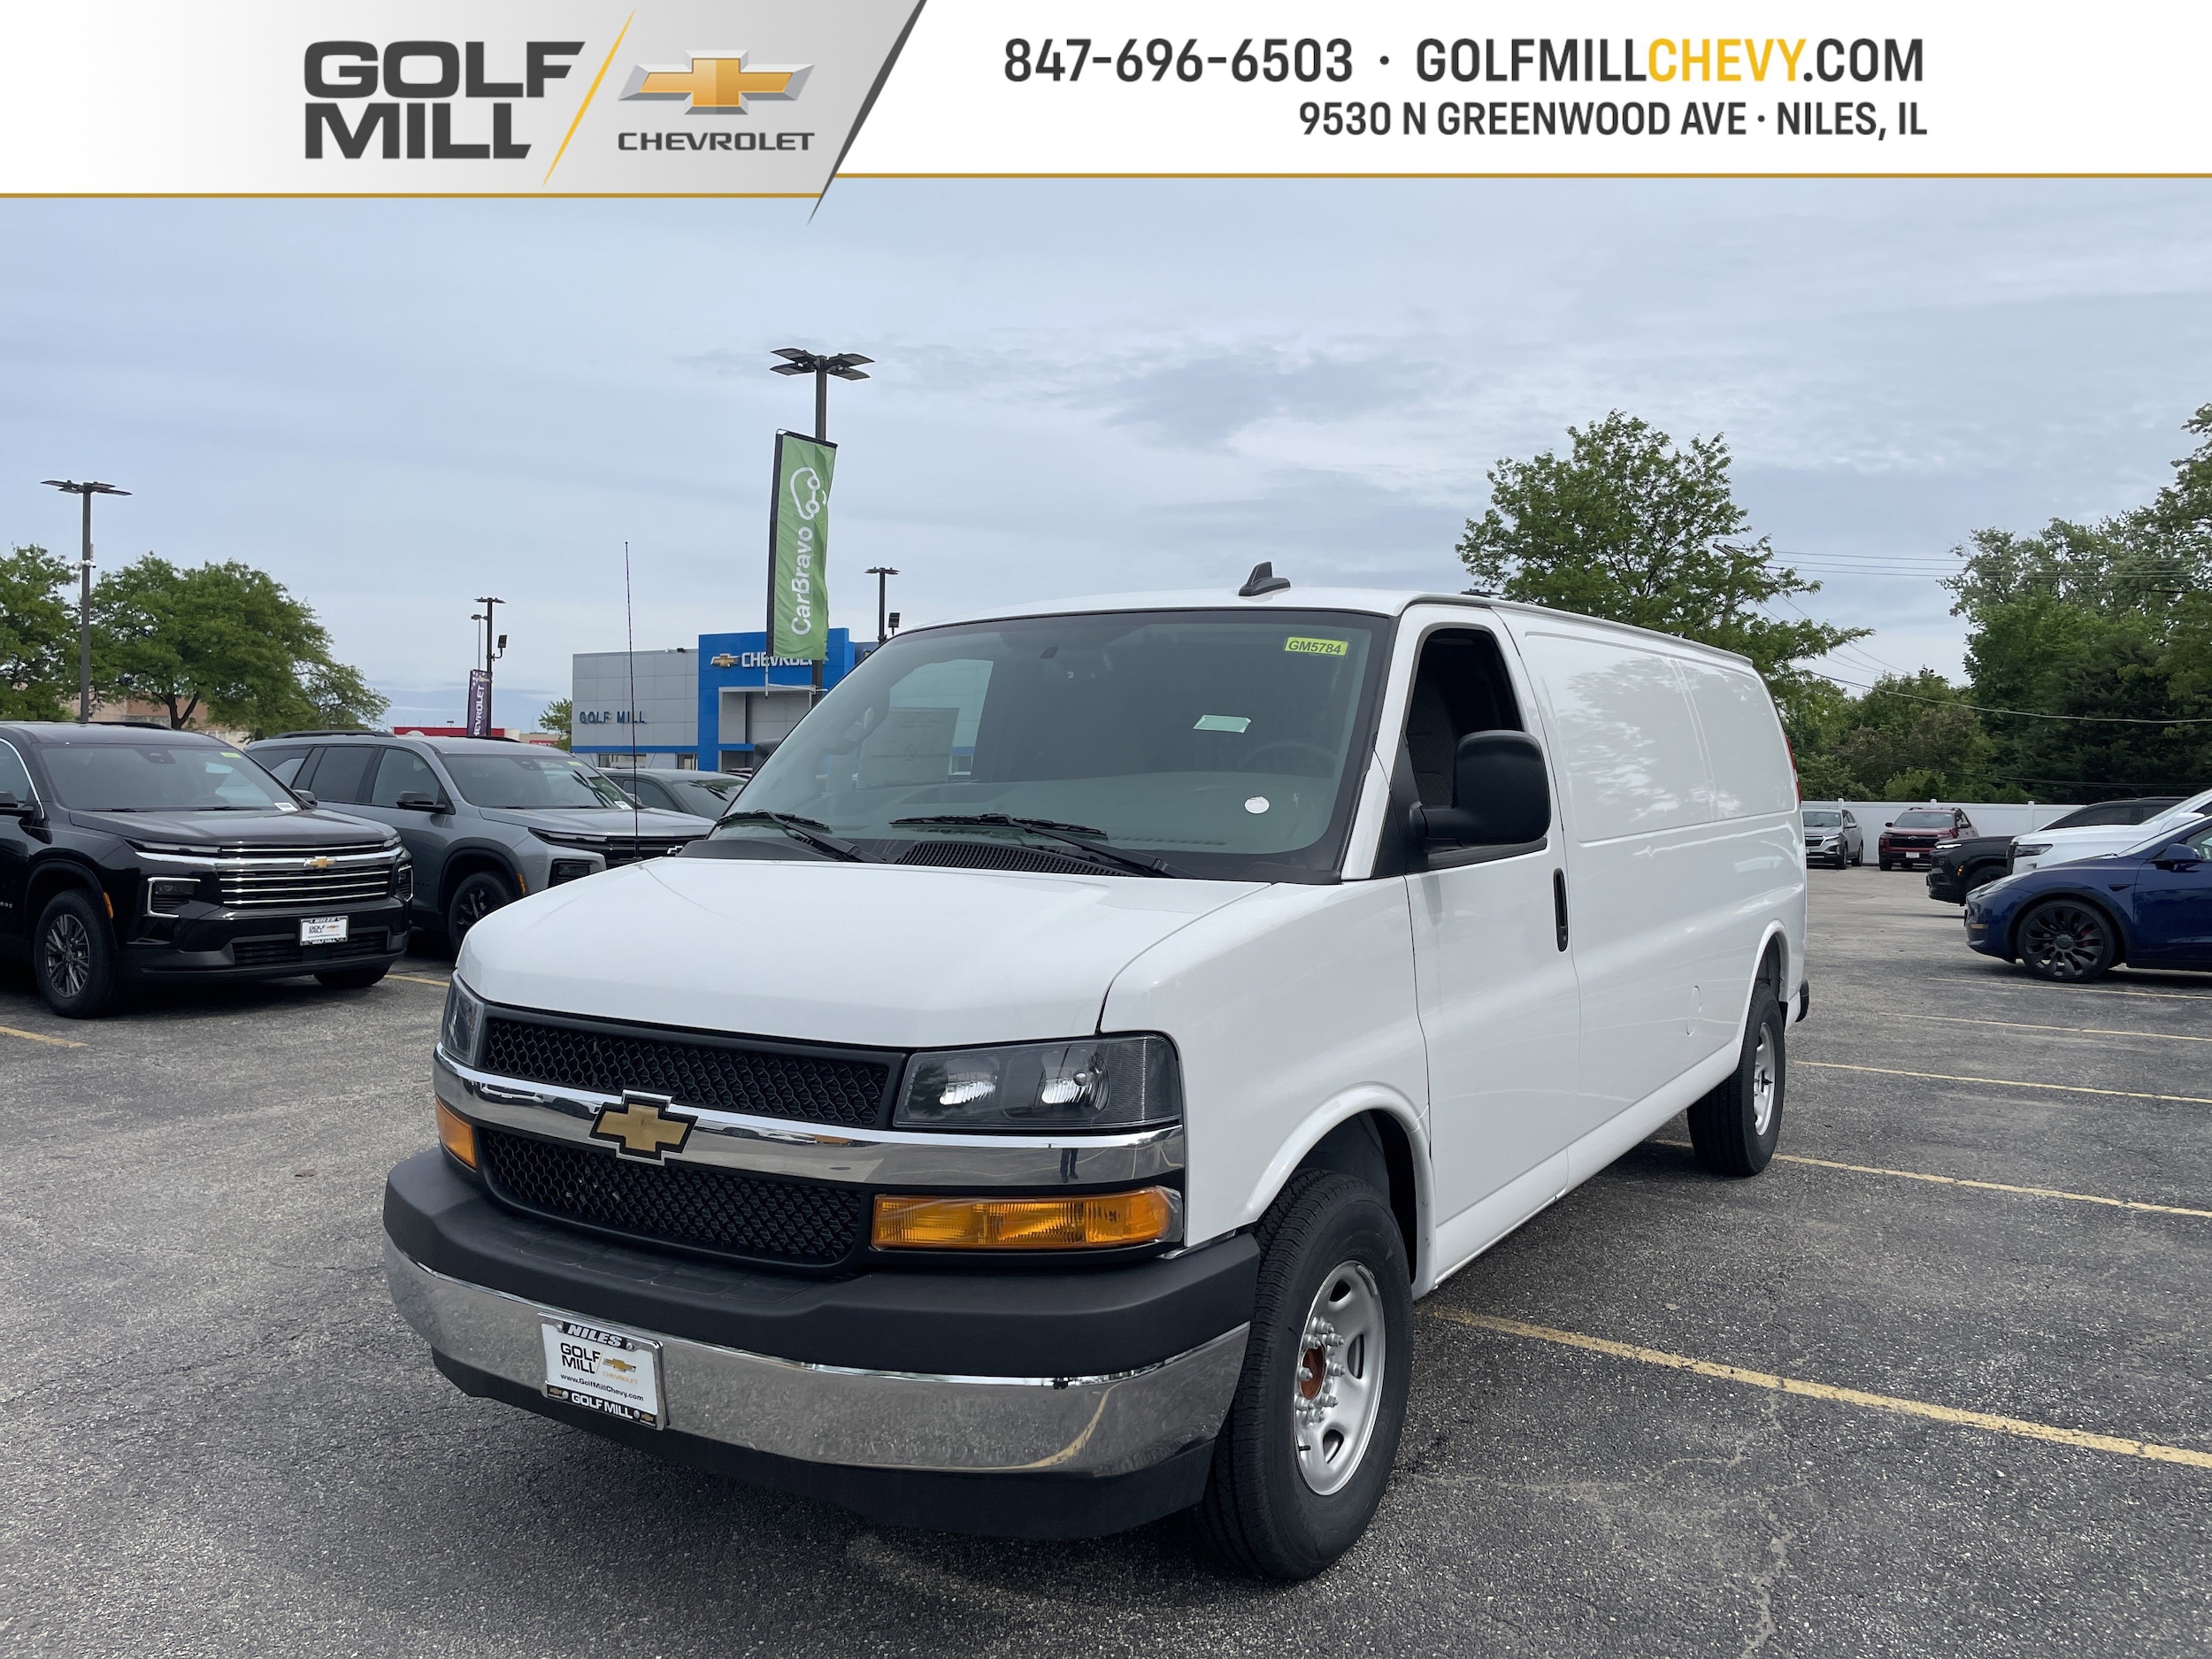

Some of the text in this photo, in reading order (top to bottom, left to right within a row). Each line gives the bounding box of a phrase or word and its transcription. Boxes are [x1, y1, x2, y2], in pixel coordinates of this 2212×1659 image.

[791, 526, 813, 635] CarBravo
[1287, 639, 1341, 655] GM5784
[473, 685, 485, 736] HEVROLET
[580, 710, 611, 724] GOLF
[567, 1324, 623, 1348] NILES
[560, 1342, 601, 1363] GOLF
[562, 1355, 595, 1374] MILL
[560, 1373, 644, 1402] www.GolfMillChevy.com
[571, 1392, 634, 1419] GOLF MILL
